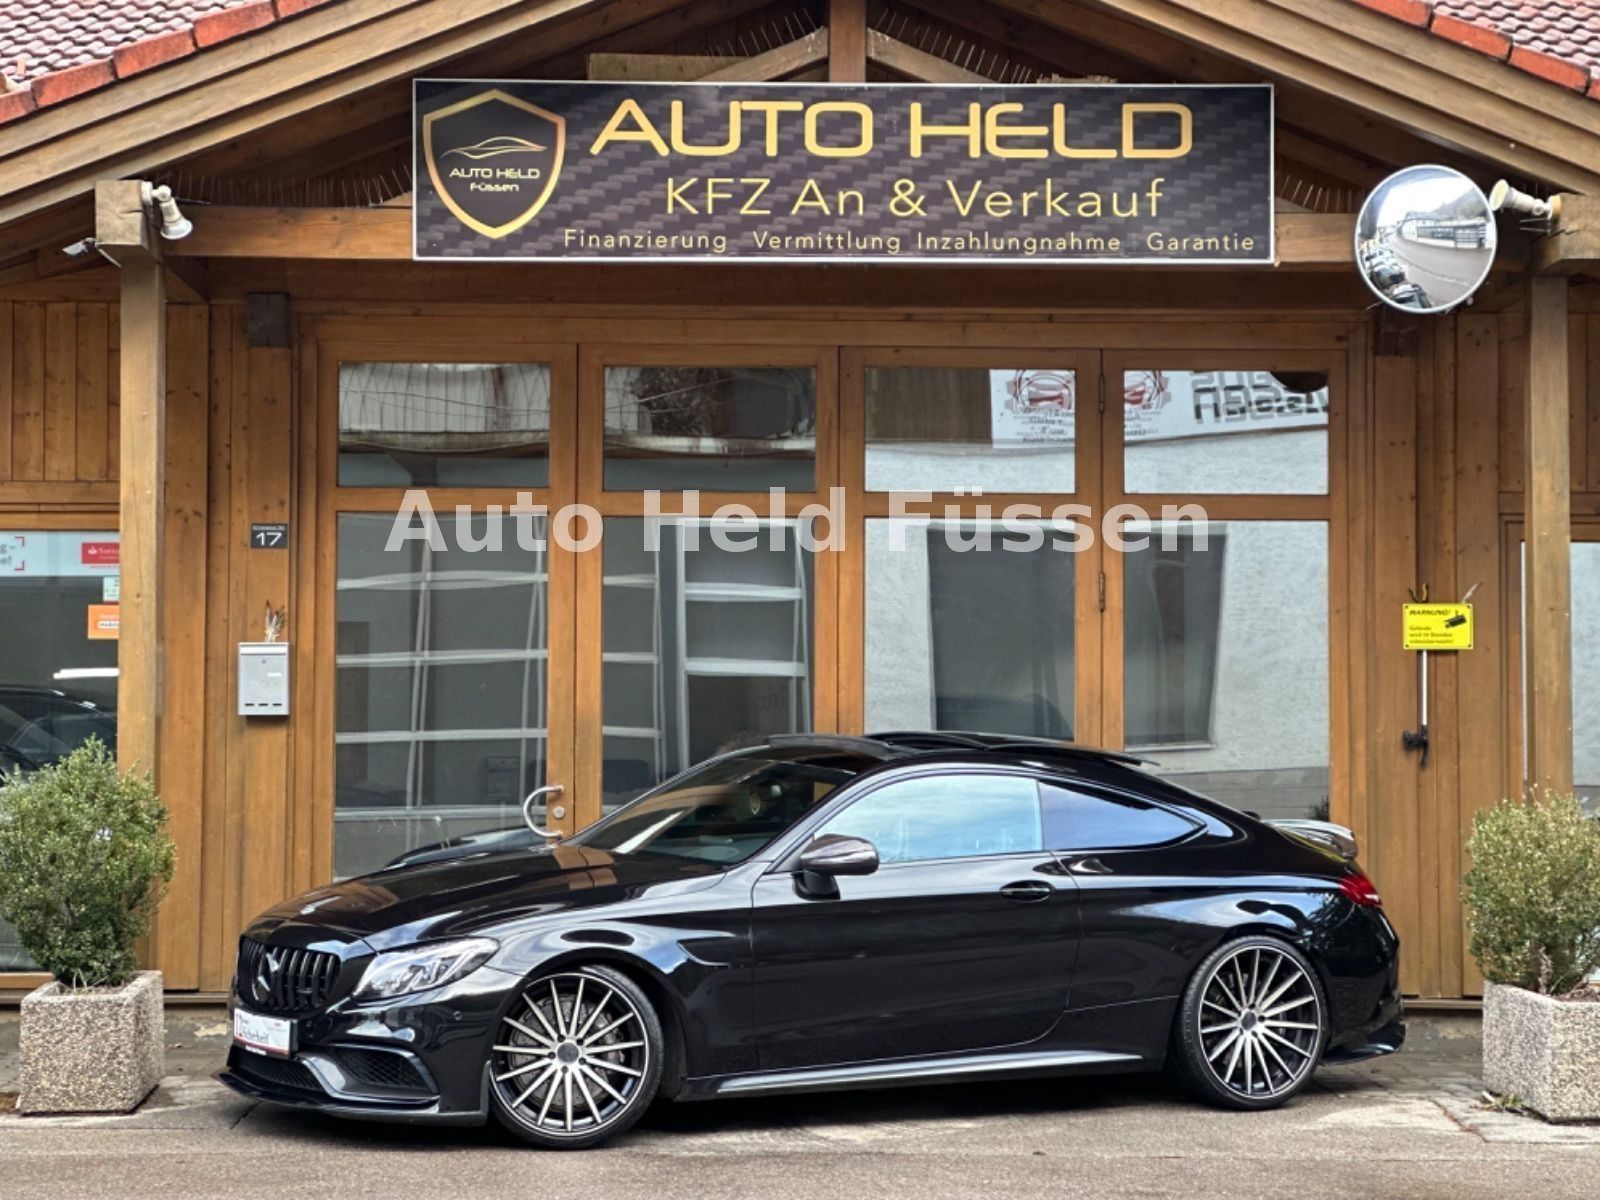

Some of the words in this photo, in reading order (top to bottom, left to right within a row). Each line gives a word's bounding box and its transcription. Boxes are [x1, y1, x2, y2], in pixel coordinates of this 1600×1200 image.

[589, 98, 873, 158] AUTO
[909, 102, 1193, 159] HELD
[449, 167, 493, 178] AUTO
[496, 168, 540, 179] HELD
[667, 177, 771, 215] KFZ
[791, 179, 864, 216] An
[889, 179, 926, 218] &
[947, 177, 1165, 218] Verkauf
[564, 230, 727, 253] Finanzierung
[753, 231, 900, 254] Vermittlung
[917, 232, 1121, 255] Inzahlungnahme
[1147, 232, 1255, 252] Garantie
[255, 531, 282, 547] 17
